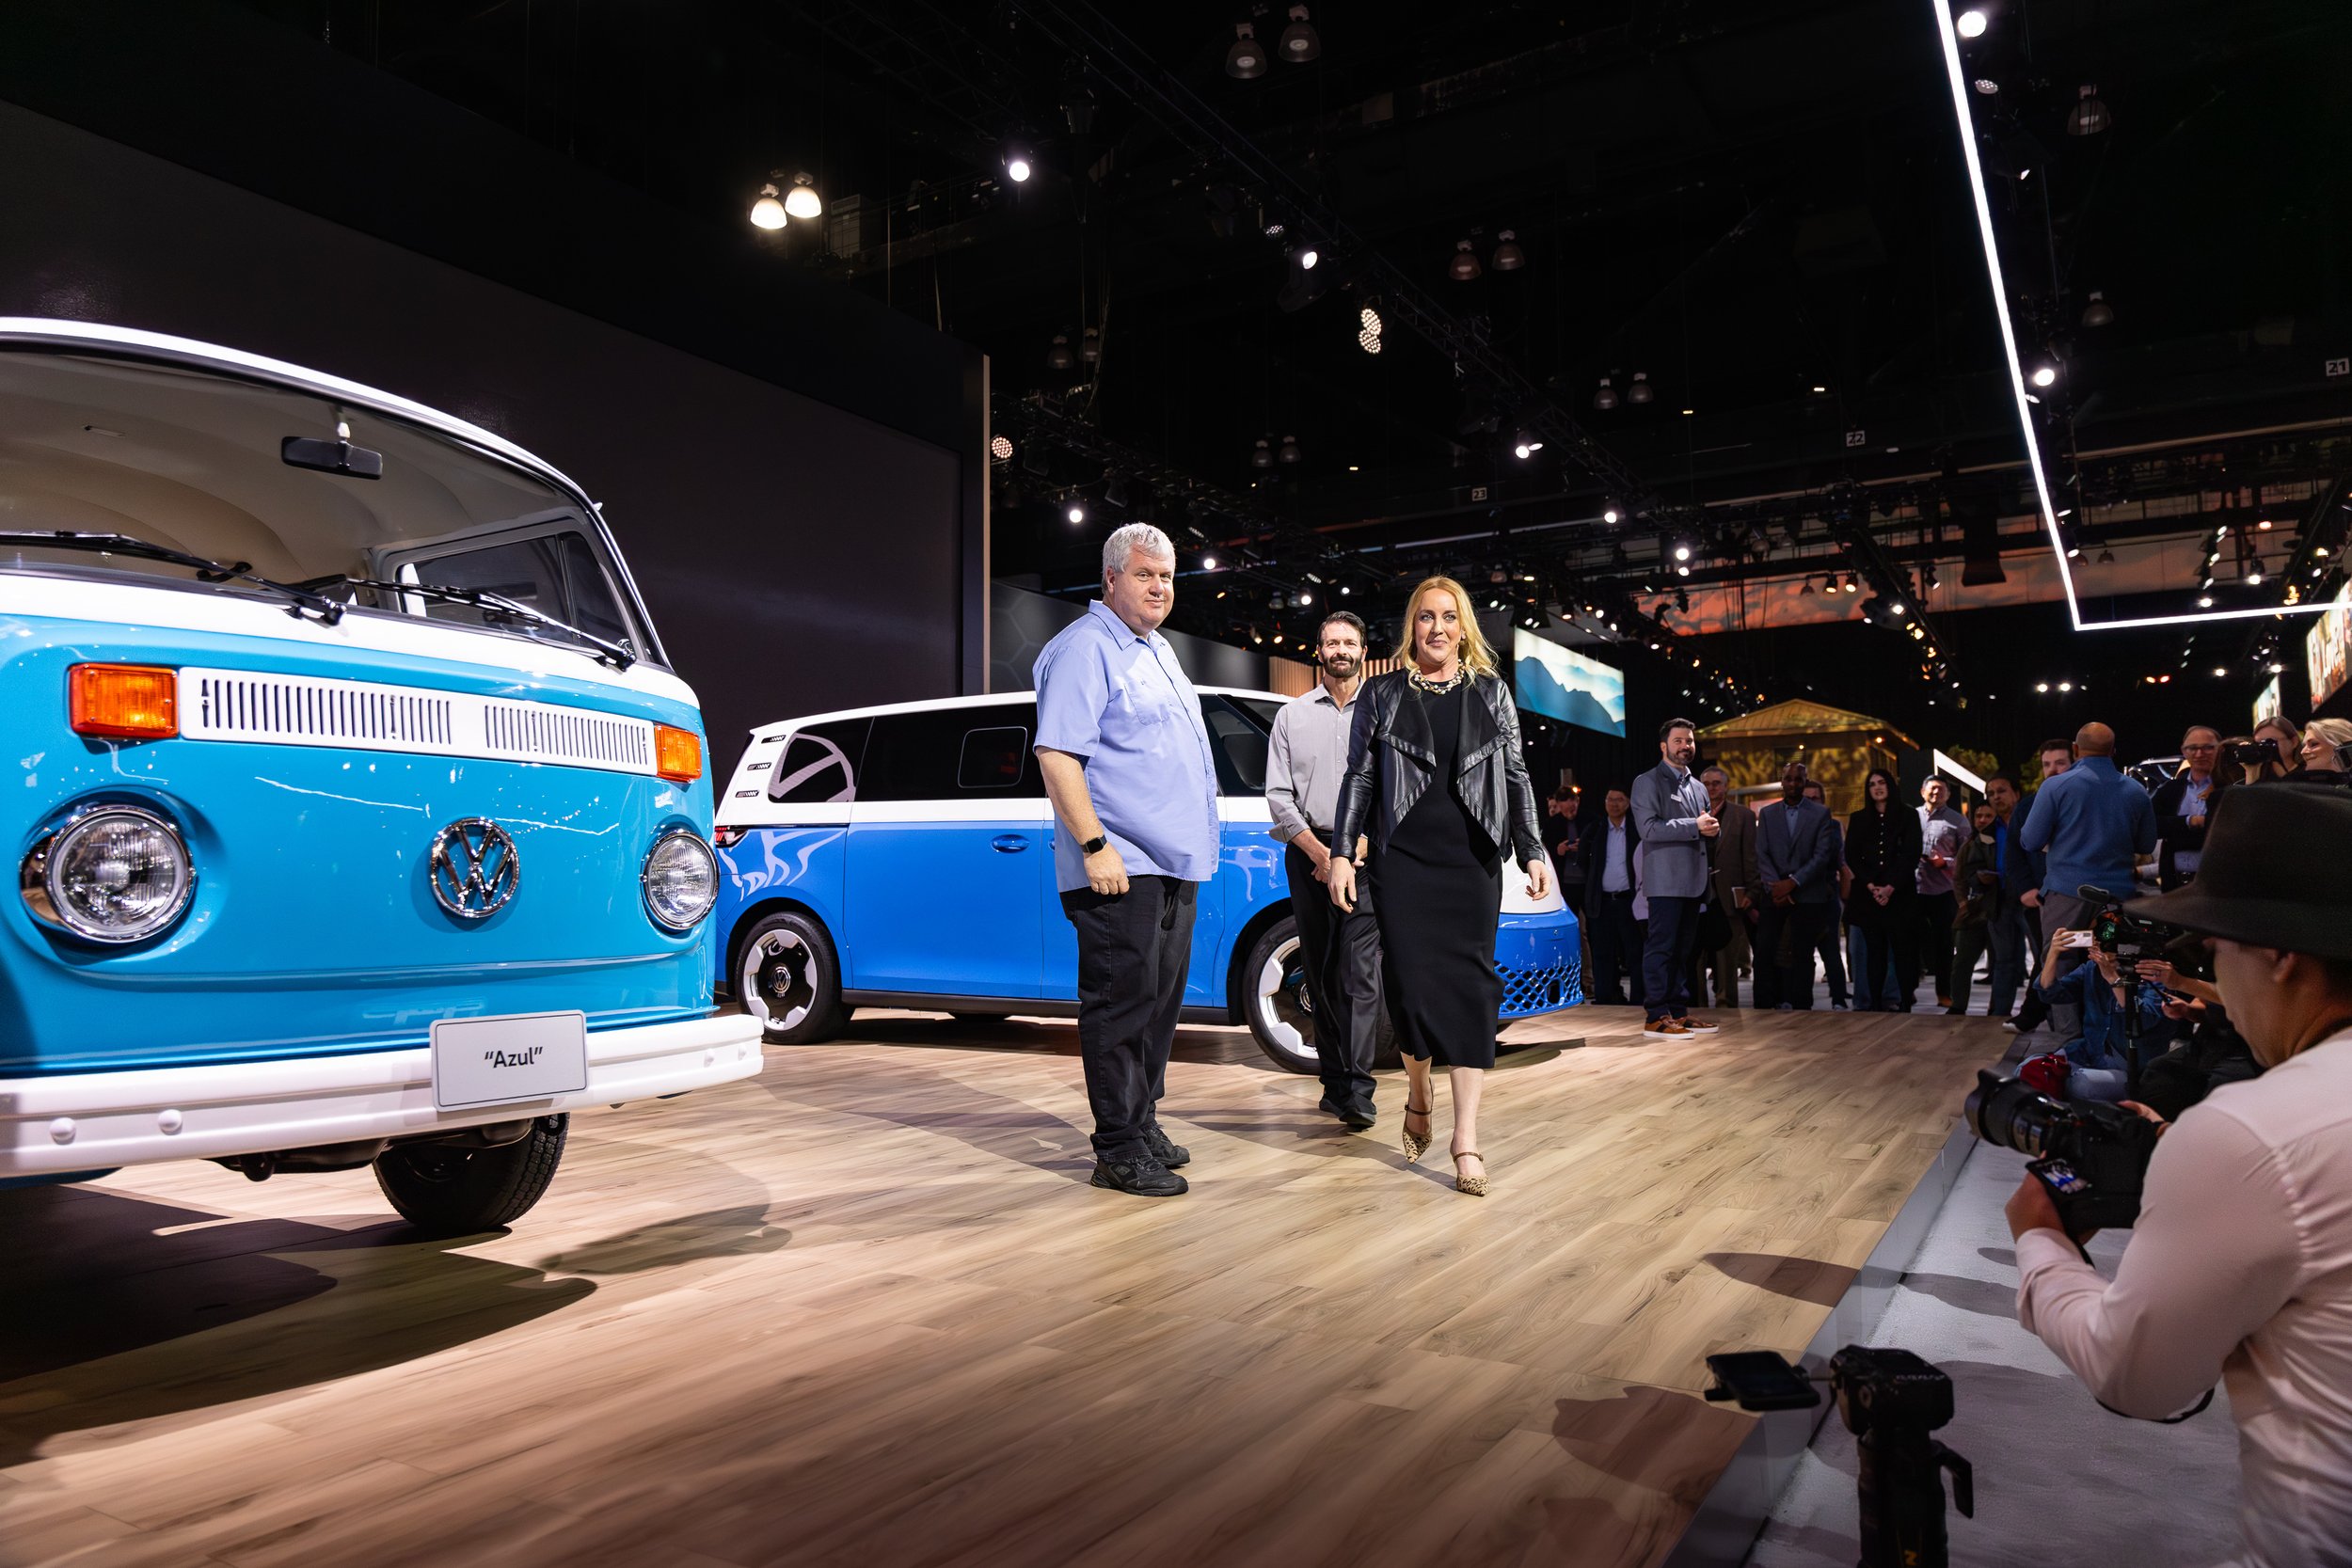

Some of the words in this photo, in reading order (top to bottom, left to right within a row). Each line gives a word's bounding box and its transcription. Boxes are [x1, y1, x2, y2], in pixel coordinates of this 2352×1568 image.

[2328, 360, 2346, 373] 21
[1848, 433, 1864, 445] 22
[1472, 488, 1486, 500] 23
